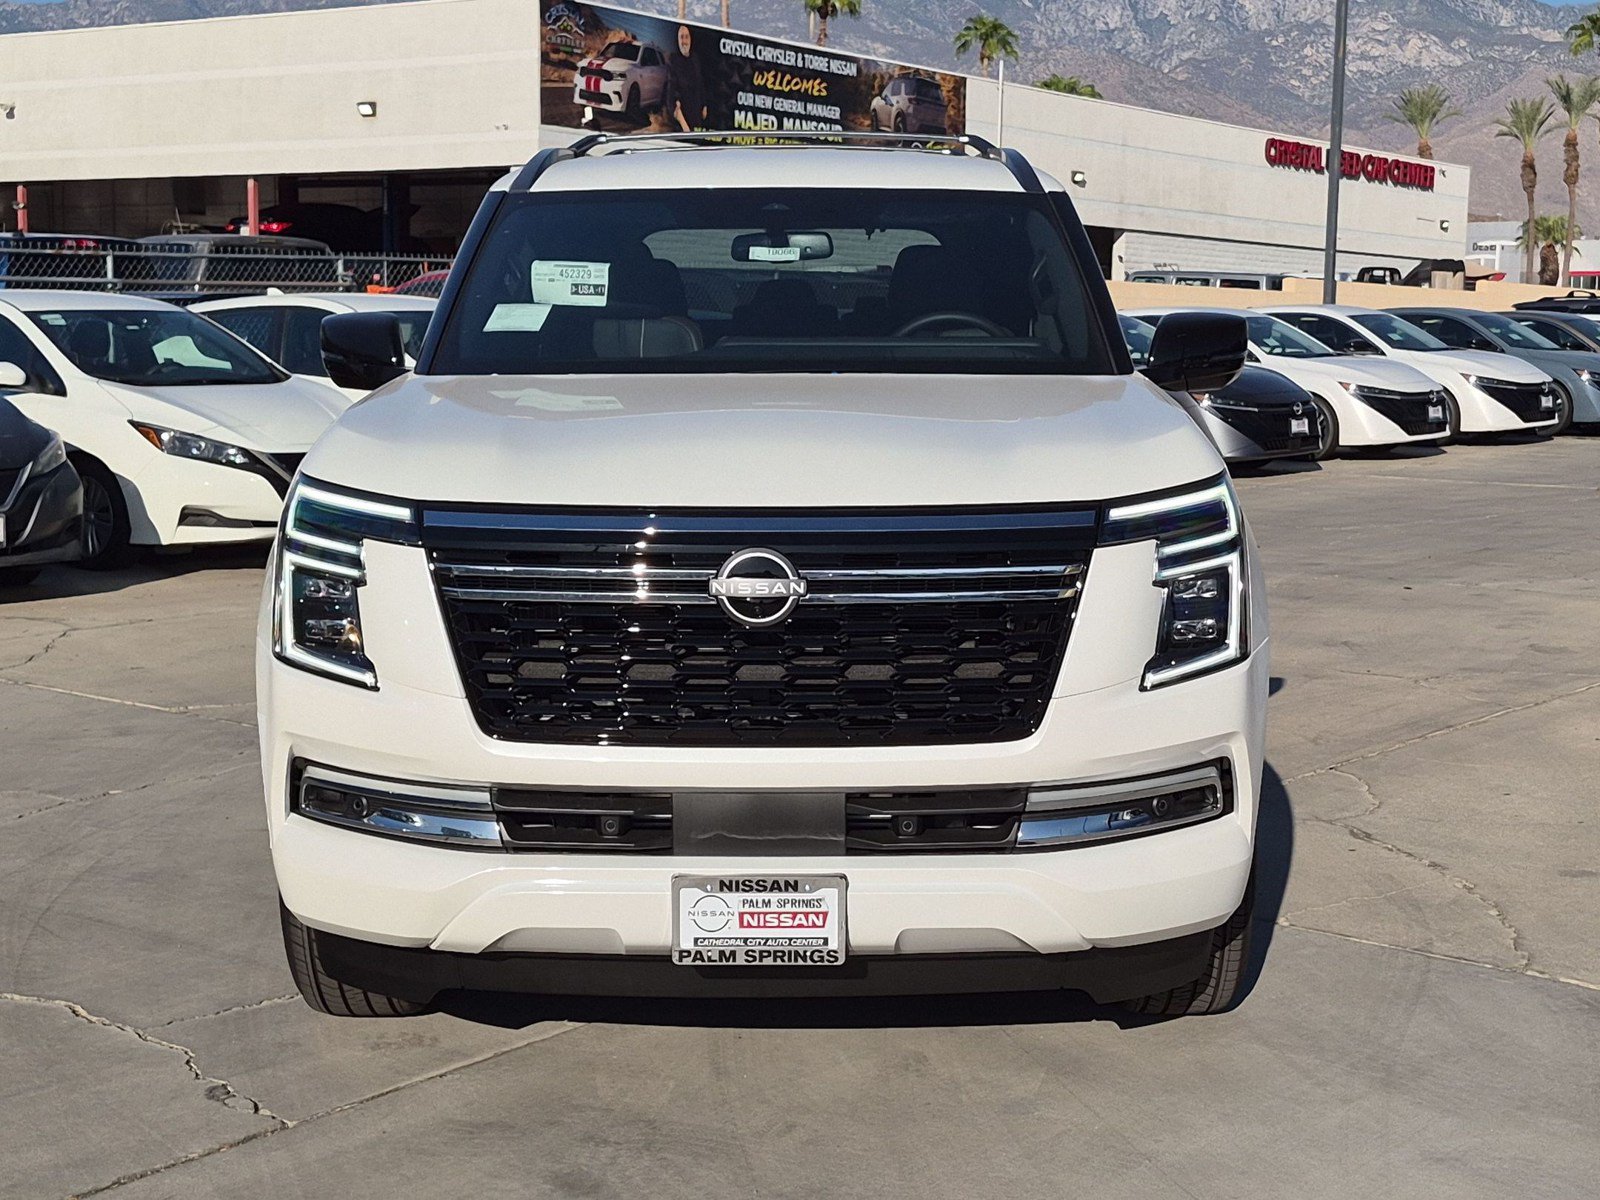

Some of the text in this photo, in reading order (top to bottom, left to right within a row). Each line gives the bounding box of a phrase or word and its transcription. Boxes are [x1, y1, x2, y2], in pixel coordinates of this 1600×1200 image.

[720, 38, 857, 77] CRYSTAL CHRYSLER & TORRE NISSAN
[753, 70, 828, 97] WELCOMES
[737, 91, 841, 120] OUR NEW GENERAL MANAGER
[734, 110, 843, 142] MAJED MANSOUR
[1265, 138, 1325, 174] CRYSTAL
[1362, 154, 1389, 184] CAR
[1389, 159, 1435, 191] CENTER
[559, 269, 592, 279] 452329
[712, 582, 805, 594] NISSAN
[719, 879, 799, 893] NISSAN
[742, 898, 823, 909] PALM SPRINGS
[743, 913, 825, 927] NISSAN
[697, 938, 824, 946] CATHEDRAL CITY AUTO CENTER
[678, 949, 839, 964] PALM SPRINGS
